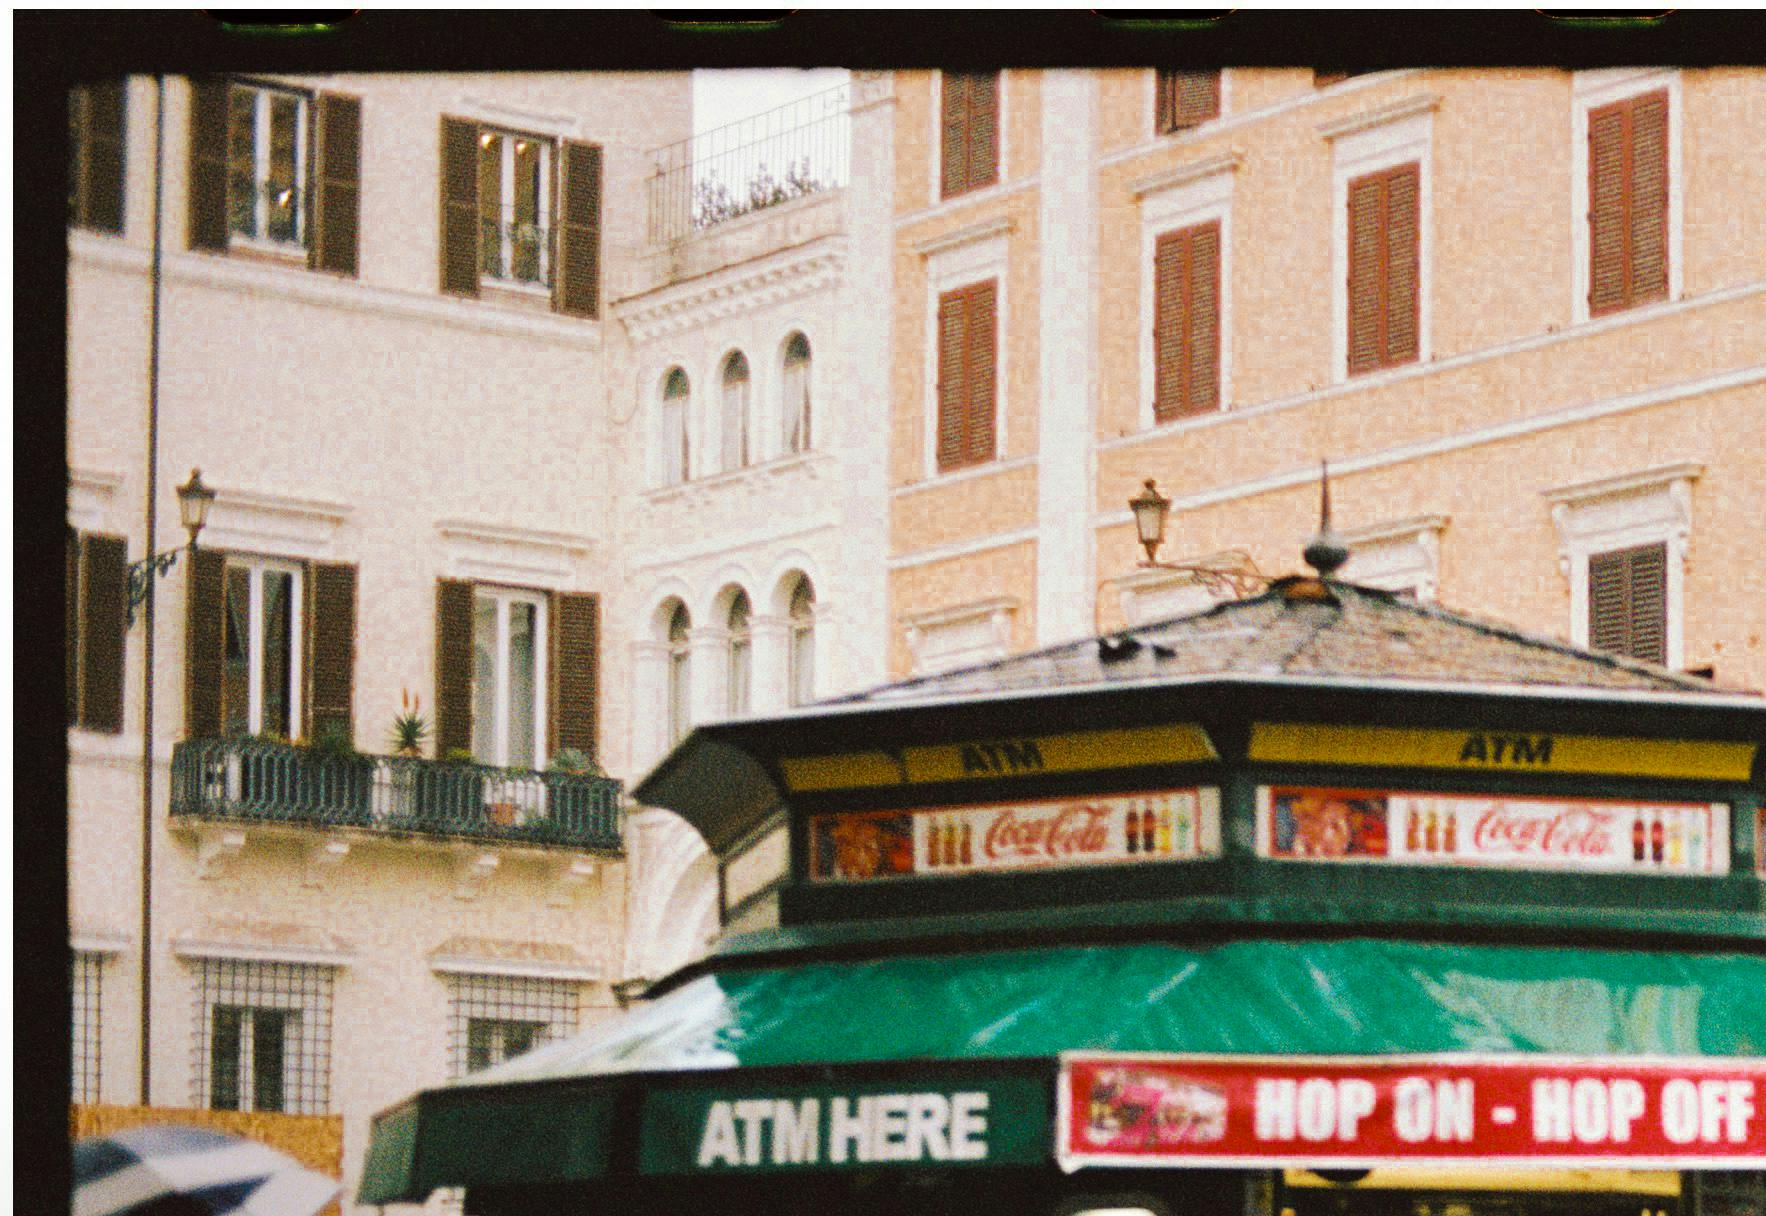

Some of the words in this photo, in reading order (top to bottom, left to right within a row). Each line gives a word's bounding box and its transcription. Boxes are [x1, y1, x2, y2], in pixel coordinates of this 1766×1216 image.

[961, 740, 1043, 773] ATM
[1460, 735, 1553, 763] ATM
[697, 1099, 820, 1167] ATM
[829, 1092, 988, 1163] HERE
[1254, 1078, 1377, 1143] HOP
[1394, 1077, 1475, 1143] ON
[1531, 1078, 1646, 1143] HOP
[1660, 1078, 1755, 1143] OFF
